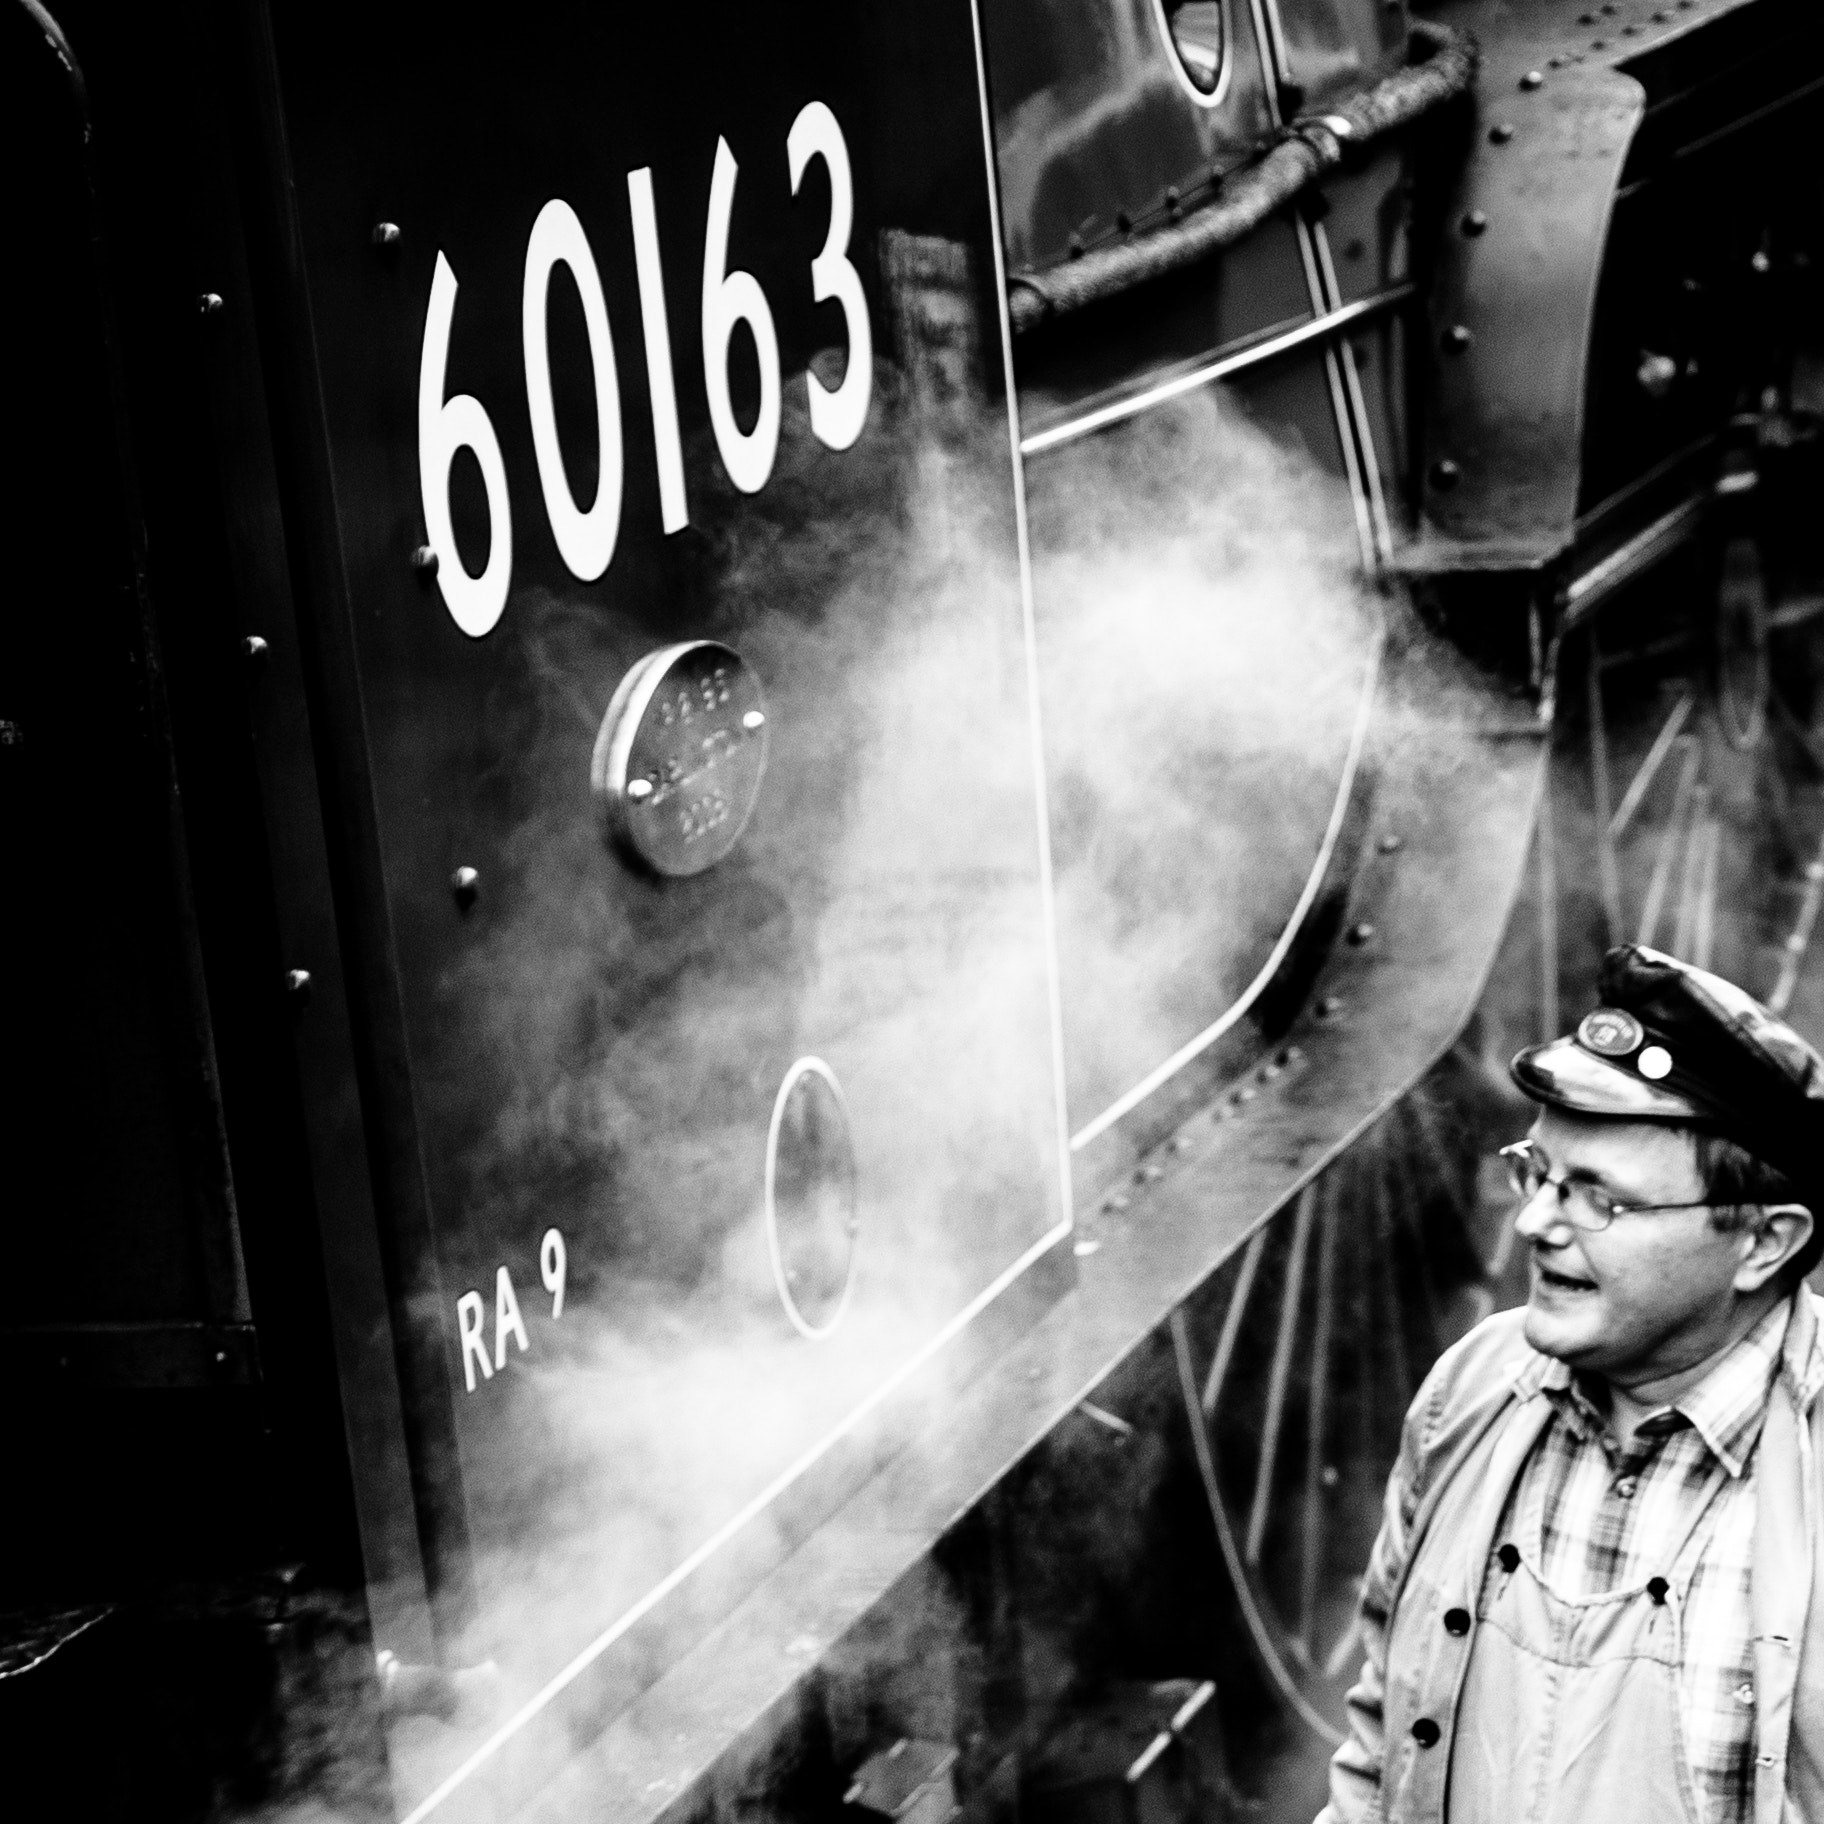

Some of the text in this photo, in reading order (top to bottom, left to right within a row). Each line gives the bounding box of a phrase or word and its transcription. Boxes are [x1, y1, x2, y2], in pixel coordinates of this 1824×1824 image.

[418, 101, 873, 638] 60163
[457, 1228, 566, 1392] RA 9
